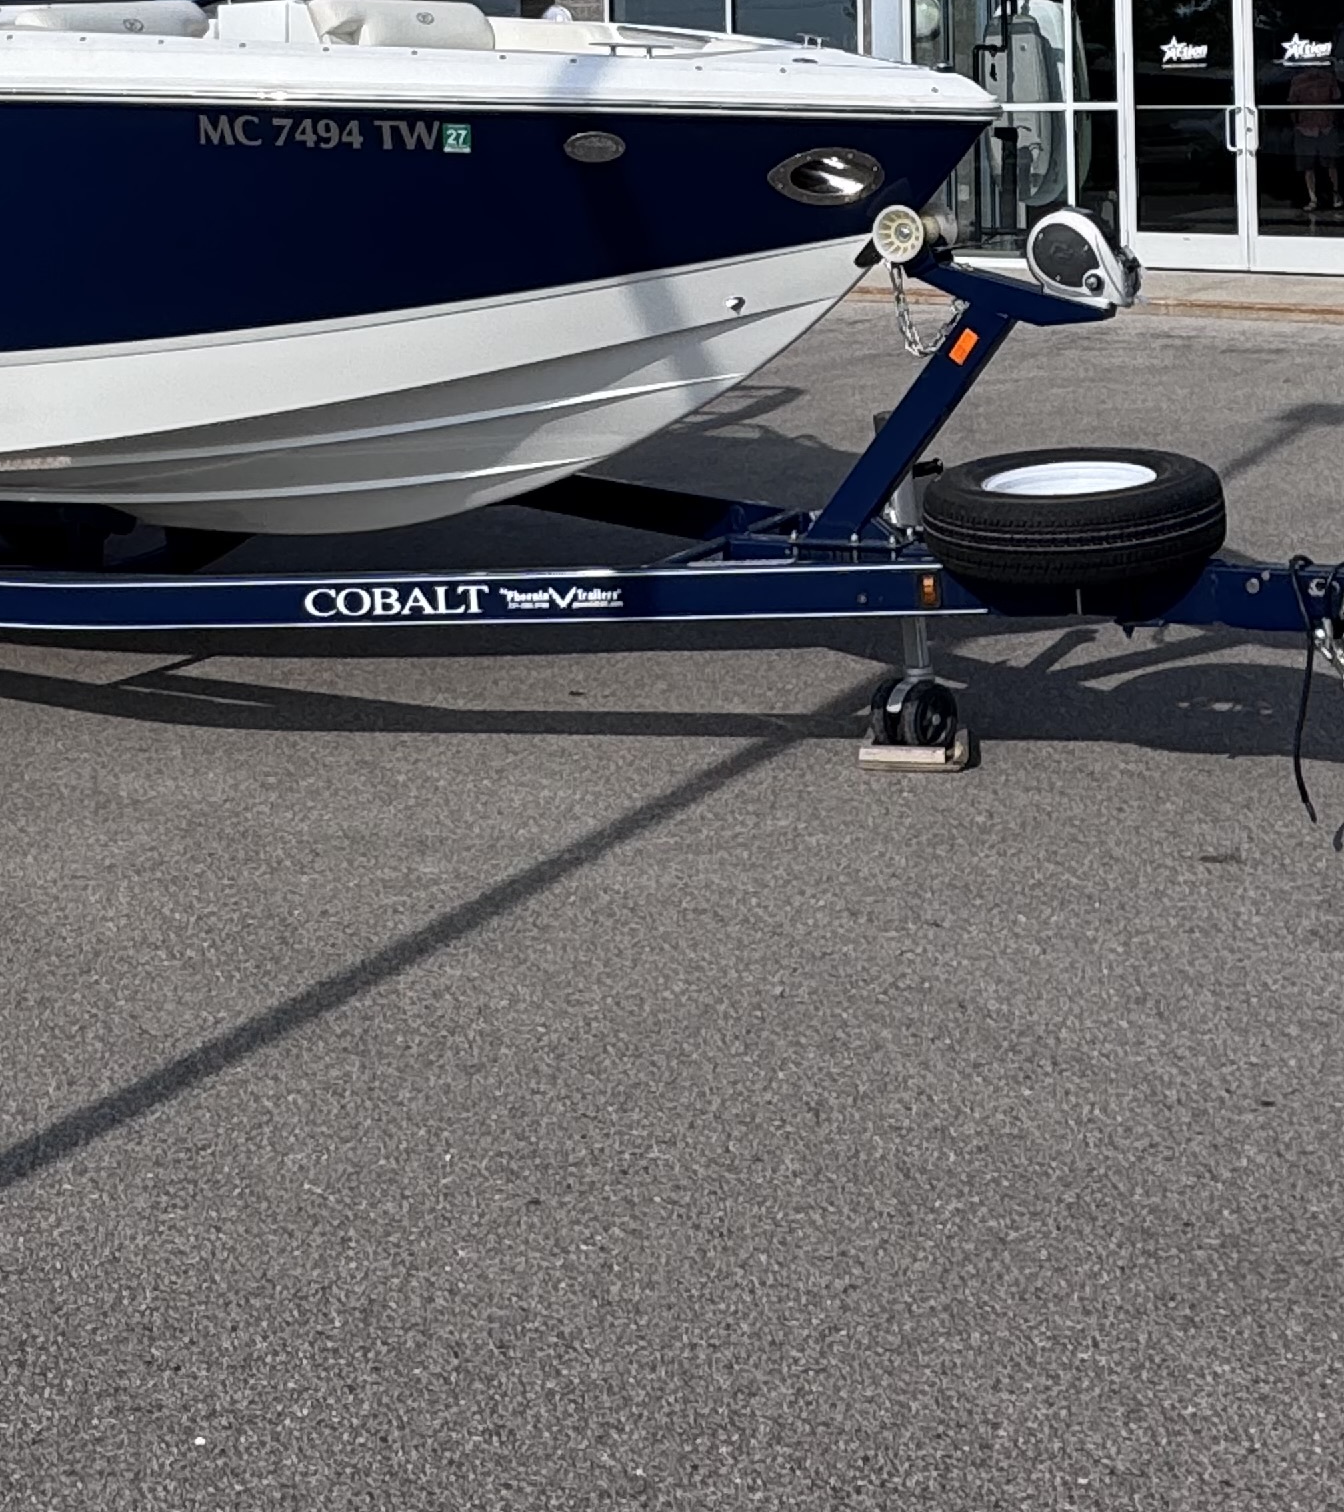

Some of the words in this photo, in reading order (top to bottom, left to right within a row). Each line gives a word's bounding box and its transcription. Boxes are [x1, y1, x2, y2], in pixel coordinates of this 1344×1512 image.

[198, 114, 263, 146] MC
[271, 118, 364, 150] 7494
[373, 120, 440, 151] TW
[446, 128, 468, 148] 27
[304, 584, 490, 617] COBALT
